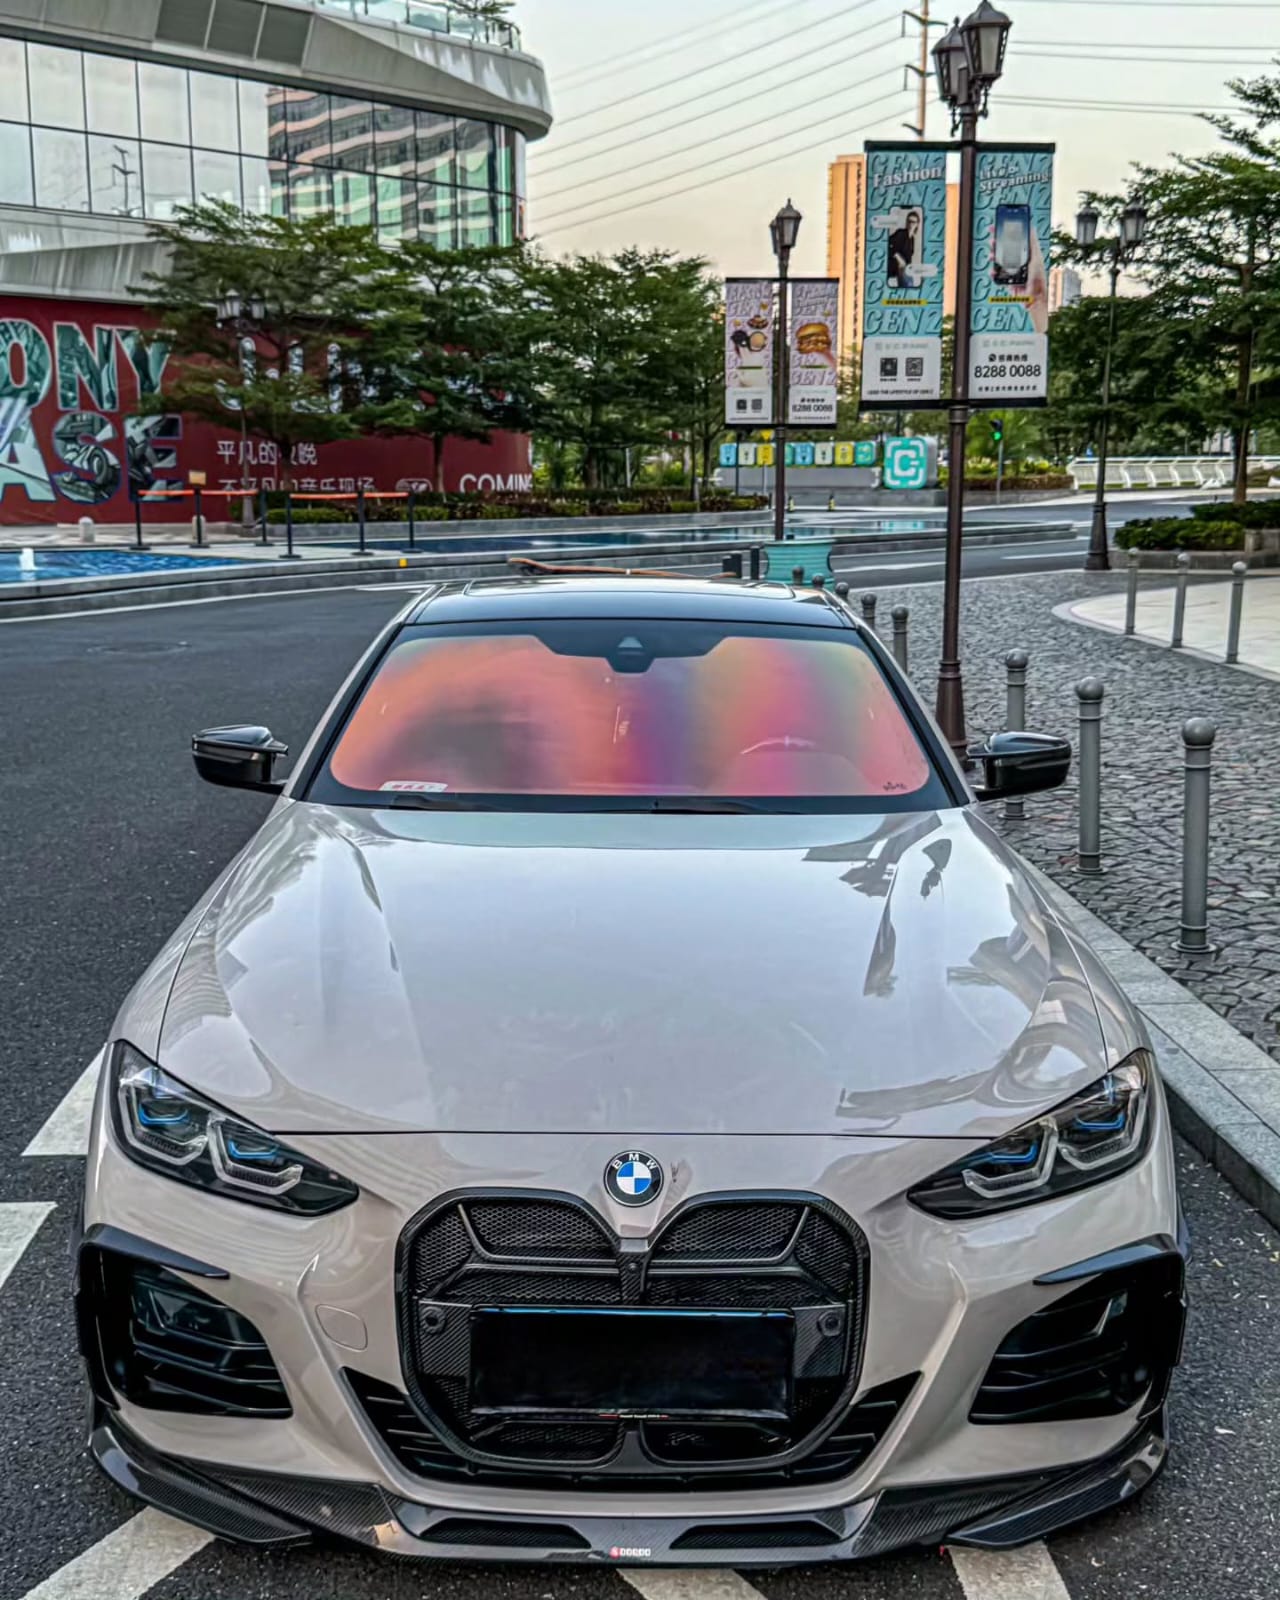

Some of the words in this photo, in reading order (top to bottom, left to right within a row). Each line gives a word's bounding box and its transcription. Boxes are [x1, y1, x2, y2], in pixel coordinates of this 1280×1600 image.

[873, 165, 943, 187] Fashion
[979, 166, 1007, 180] Live
[979, 172, 1050, 191] Streaming
[0, 317, 177, 411] ONY
[974, 365, 1007, 378] 8288
[1009, 364, 1041, 377] 0088
[0, 398, 183, 505] ASE
[217, 440, 318, 465] 平凡的晚
[611, 1153, 658, 1170] BMW
